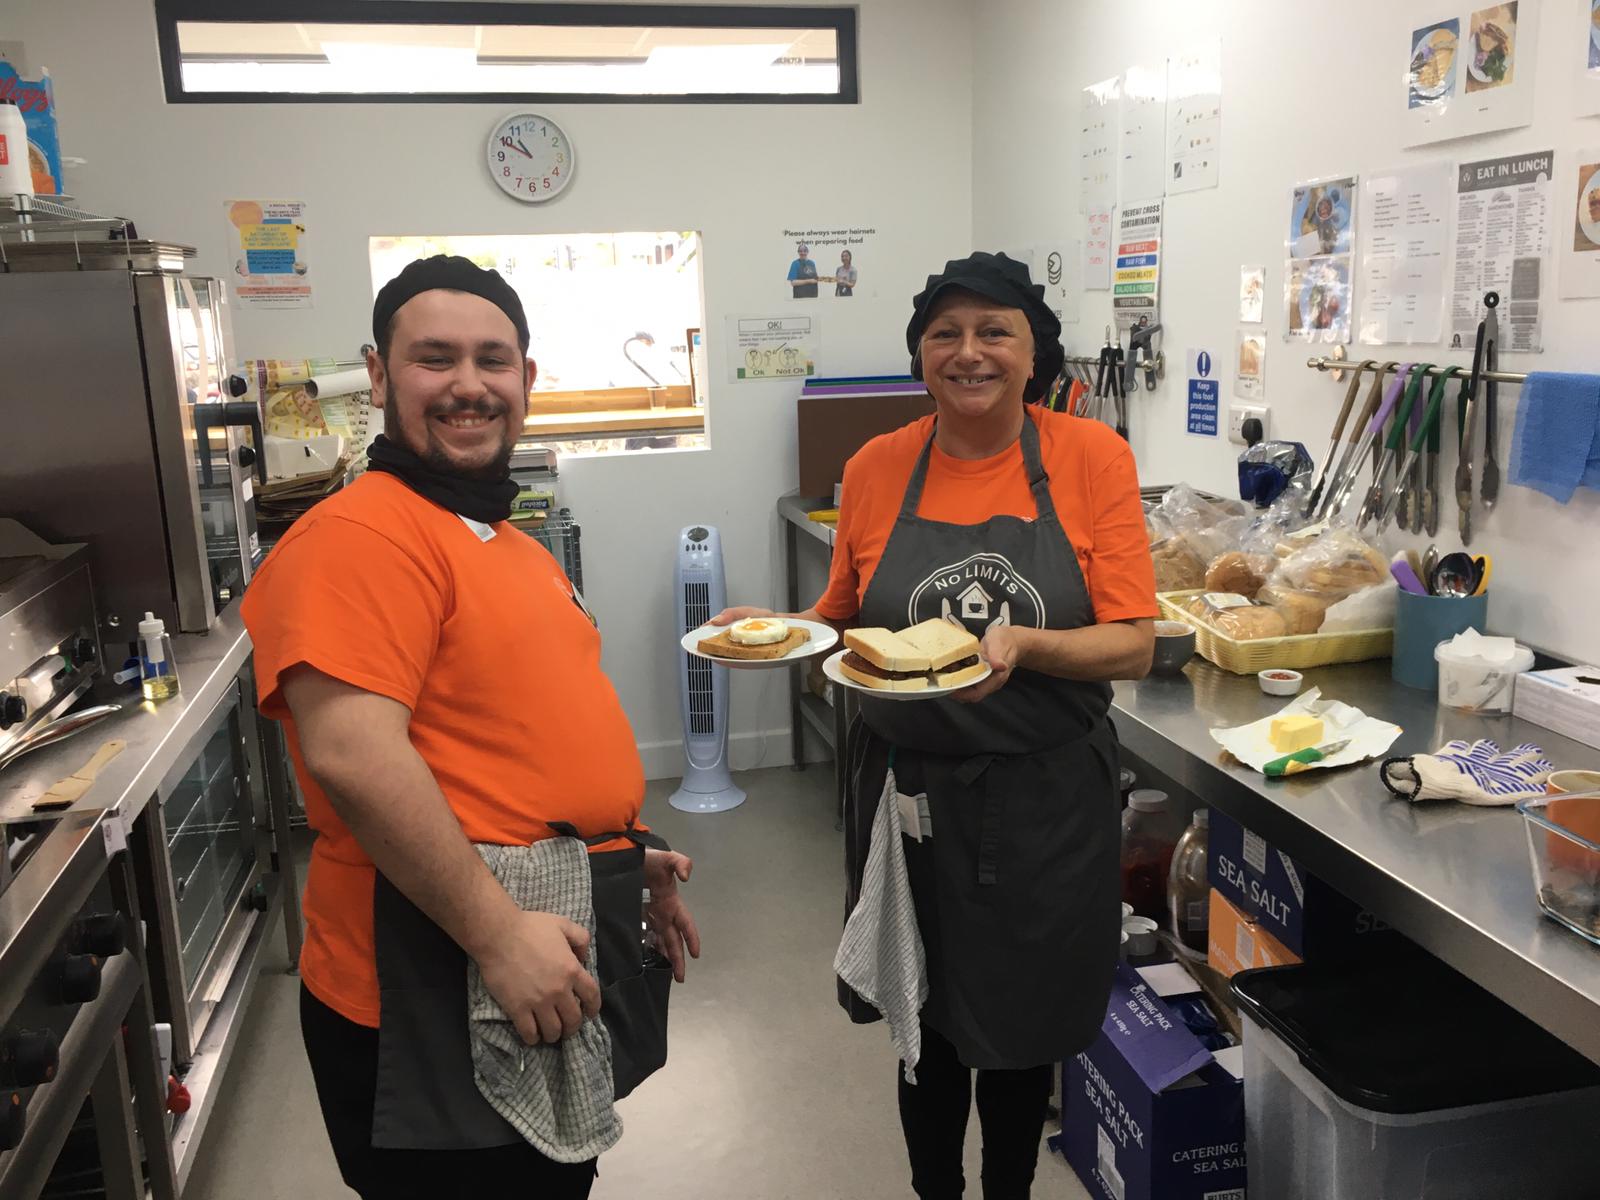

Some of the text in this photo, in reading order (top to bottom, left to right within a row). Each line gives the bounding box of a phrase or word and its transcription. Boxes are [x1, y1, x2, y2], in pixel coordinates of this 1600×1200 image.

[509, 125, 520, 136] 11
[522, 121, 535, 132] 12
[540, 126, 547, 137] 1
[499, 136, 513, 147] 10
[552, 137, 559, 148] 2
[497, 151, 505, 162] 9
[556, 152, 564, 163] 3
[503, 166, 511, 177] 8
[552, 166, 560, 177] 4
[1477, 157, 1549, 180] EAT IN LUNCH
[515, 177, 523, 188] 7
[529, 182, 536, 193] 6
[543, 177, 551, 189] 5
[1122, 207, 1142, 218] PREVENT
[1143, 204, 1160, 215] CROSS
[1121, 216, 1160, 229] CONTAMINATION
[806, 229, 830, 237] always
[849, 227, 876, 235] hairnets
[815, 238, 848, 246] preparing
[1125, 255, 1147, 265] RAW FISH
[1119, 270, 1153, 280] COOKED MEATS
[767, 320, 782, 330] OK!
[1197, 382, 1210, 392] Keep
[1193, 392, 1214, 401] this food
[1190, 403, 1216, 411] production
[1202, 413, 1215, 421] clean
[1190, 422, 1195, 430] at
[1202, 423, 1215, 432] times
[934, 564, 1019, 595] NO LIMITS
[1219, 855, 1248, 894] SEA
[1250, 880, 1291, 927] SALT
[1126, 1000, 1154, 1027] SEA SALT
[1129, 986, 1173, 1031] CATERING PACK
[1077, 1052, 1143, 1150] ATERING PACK
[1085, 1080, 1128, 1148] SEA SALT
[1172, 1142, 1239, 1162] CATERING
[1193, 1157, 1248, 1174] SEA SAL
